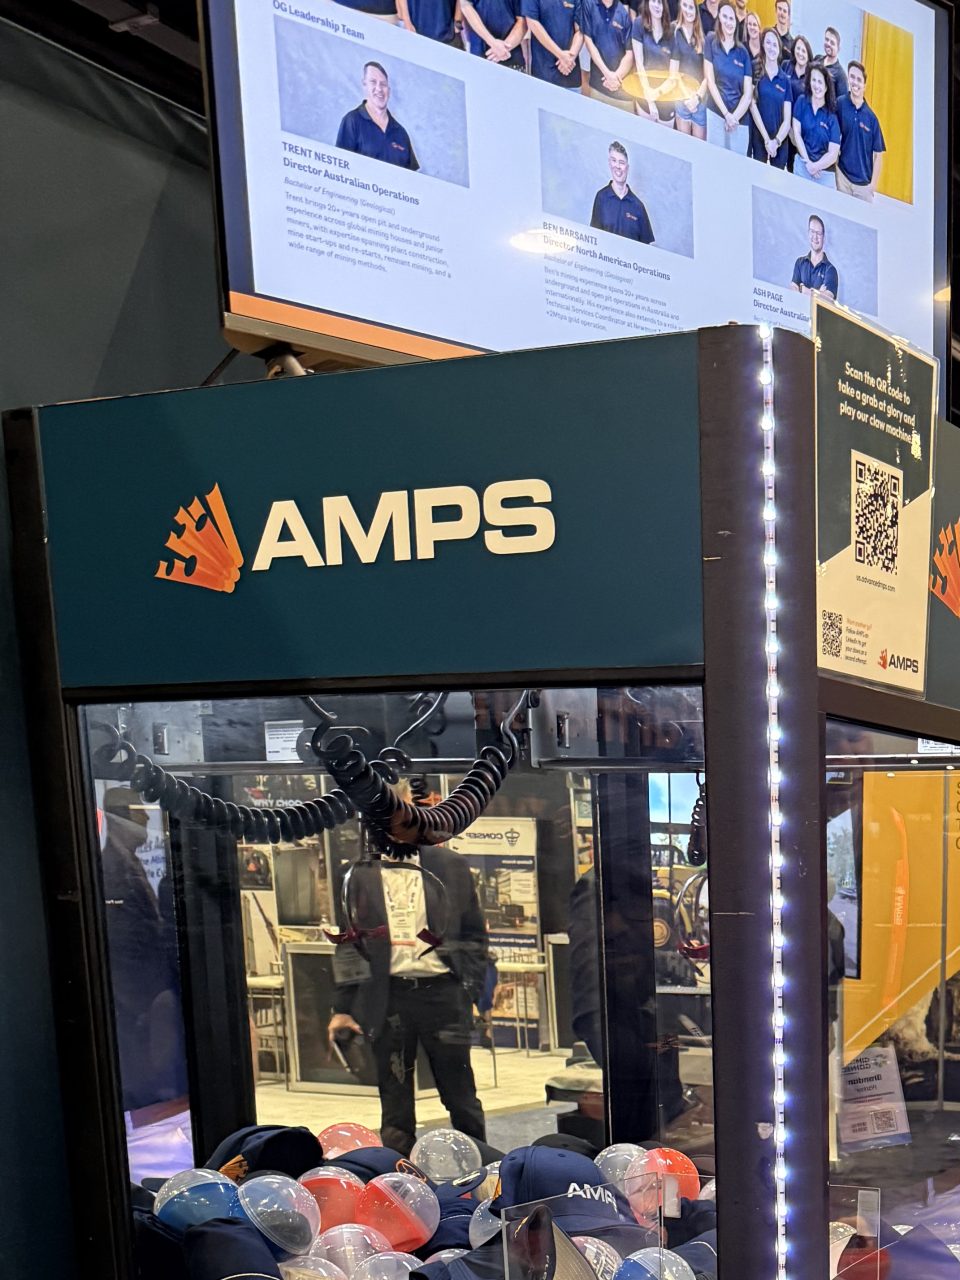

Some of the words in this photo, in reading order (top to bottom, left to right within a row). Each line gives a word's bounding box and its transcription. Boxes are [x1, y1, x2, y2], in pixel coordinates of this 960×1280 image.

[289, 6, 340, 32] Leadership
[342, 24, 364, 40] Team
[282, 142, 312, 158] TRENT
[314, 152, 350, 170] NESTER
[283, 158, 322, 176] Director
[324, 169, 370, 190] Australian
[372, 184, 420, 206] Operations
[286, 192, 303, 203] Trent
[305, 197, 326, 210] brings
[328, 204, 340, 212] 20+
[341, 209, 360, 219] years
[361, 214, 376, 224] open
[388, 222, 400, 230] and
[401, 226, 440, 242] underground
[286, 206, 322, 221] experience
[368, 228, 389, 240] mining
[414, 240, 424, 248] and
[543, 222, 558, 235] BEN
[560, 226, 598, 246] BARSANTI
[288, 242, 304, 251] wide
[306, 246, 325, 256] range
[334, 253, 356, 266] mining
[338, 242, 350, 252] and
[435, 269, 446, 277] and
[544, 235, 574, 252] Director
[576, 245, 598, 259] North
[598, 252, 632, 270] American
[633, 262, 671, 281] Operations
[753, 288, 766, 298] ASH
[768, 292, 784, 302] PAGE
[754, 300, 780, 313] Director
[845, 362, 862, 382] Scan
[864, 370, 876, 387] the
[876, 378, 887, 394] QR
[888, 386, 903, 400] code
[904, 392, 910, 405] to
[838, 379, 854, 398] take
[856, 392, 861, 400] a
[862, 392, 878, 408] grab
[879, 398, 886, 411] at
[887, 402, 903, 422] glory
[904, 414, 916, 426] and
[840, 402, 856, 421] play
[856, 410, 869, 422] our
[870, 414, 885, 431] claw
[251, 478, 556, 572] AMPS
[889, 654, 918, 674] AMPS
